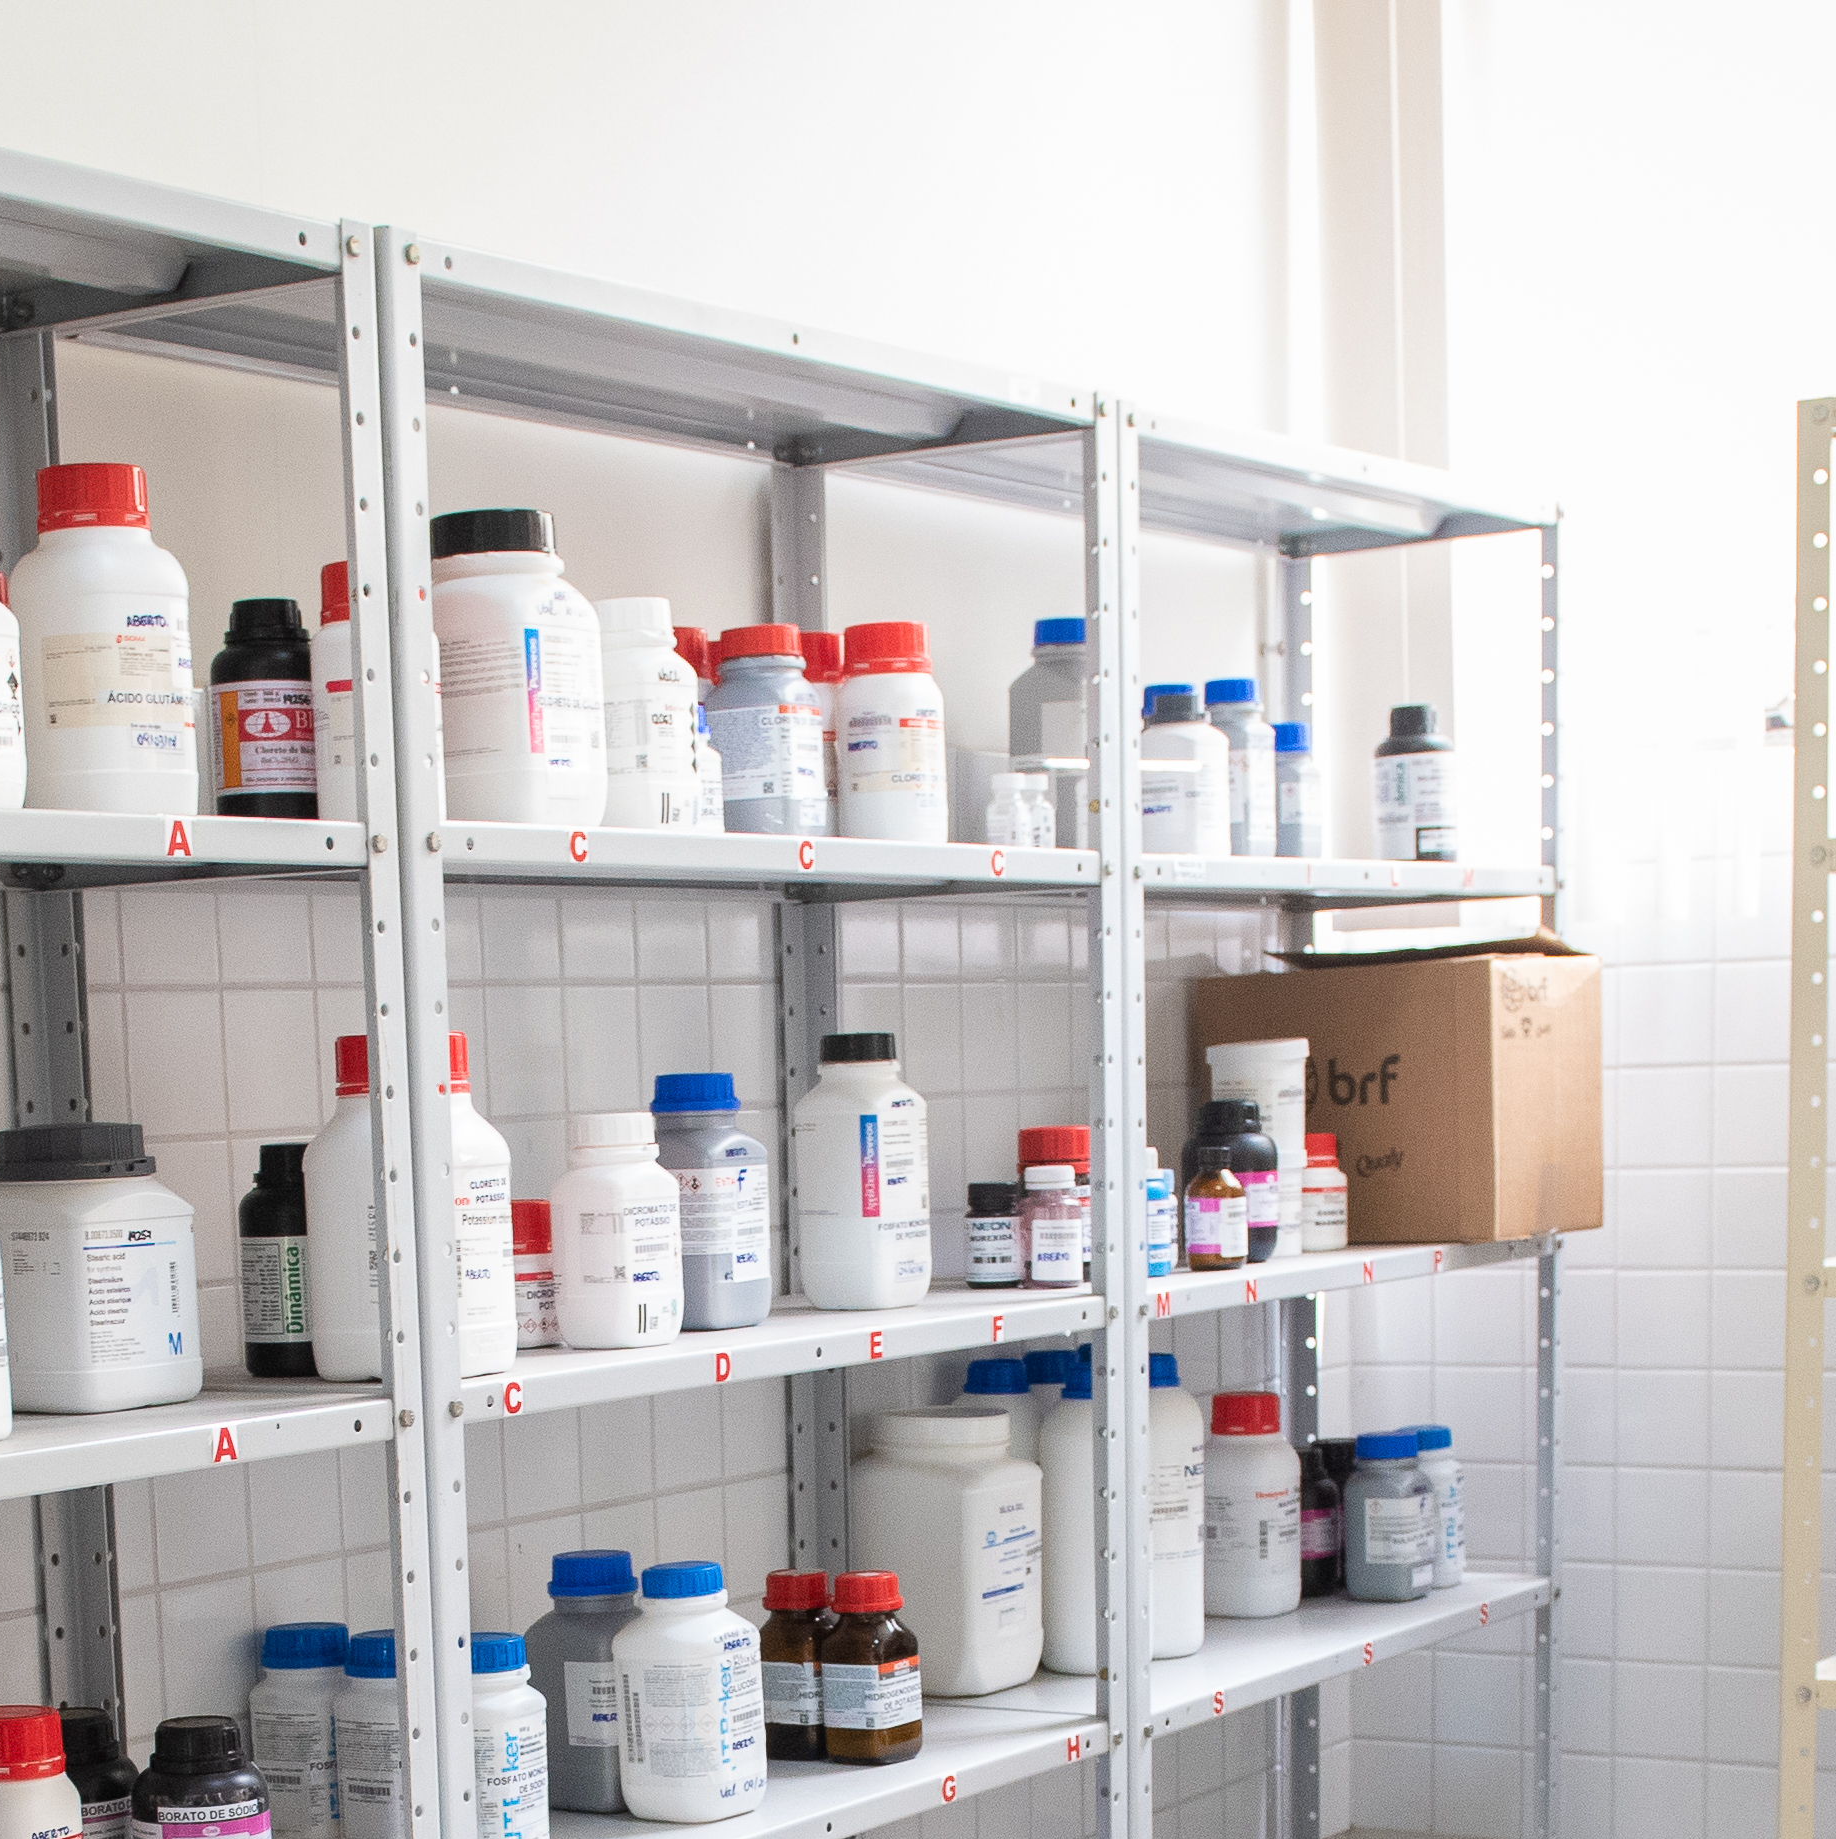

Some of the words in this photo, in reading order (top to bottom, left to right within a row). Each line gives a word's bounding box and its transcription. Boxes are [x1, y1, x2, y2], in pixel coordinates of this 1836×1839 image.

[107, 691, 143, 705] ÁCIDO
[167, 821, 192, 856] A
[570, 832, 587, 862] C
[799, 840, 813, 869] C
[992, 850, 1004, 876] C
[1328, 1054, 1401, 1106] brf
[971, 1221, 1012, 1231] NEON
[1363, 1262, 1373, 1283] N
[1435, 1250, 1443, 1271] P
[285, 1245, 305, 1334] Dinâmica
[1246, 1280, 1257, 1302] N
[1157, 1293, 1171, 1316] M
[993, 1316, 1004, 1342] F
[168, 1331, 183, 1356] M
[870, 1331, 882, 1359] E
[715, 1353, 731, 1382] D
[504, 1382, 522, 1413] C
[214, 1427, 237, 1462] A
[1479, 1602, 1488, 1625] S
[1363, 1642, 1373, 1665] S
[1213, 1691, 1224, 1714] S
[1067, 1735, 1080, 1761] H
[487, 1773, 527, 1787] FOSFATO
[518, 1783, 530, 1794] DE
[942, 1776, 956, 1801] G
[81, 1801, 125, 1816] BORATO
[158, 1808, 206, 1823] BORATO
[209, 1808, 226, 1820] DE
